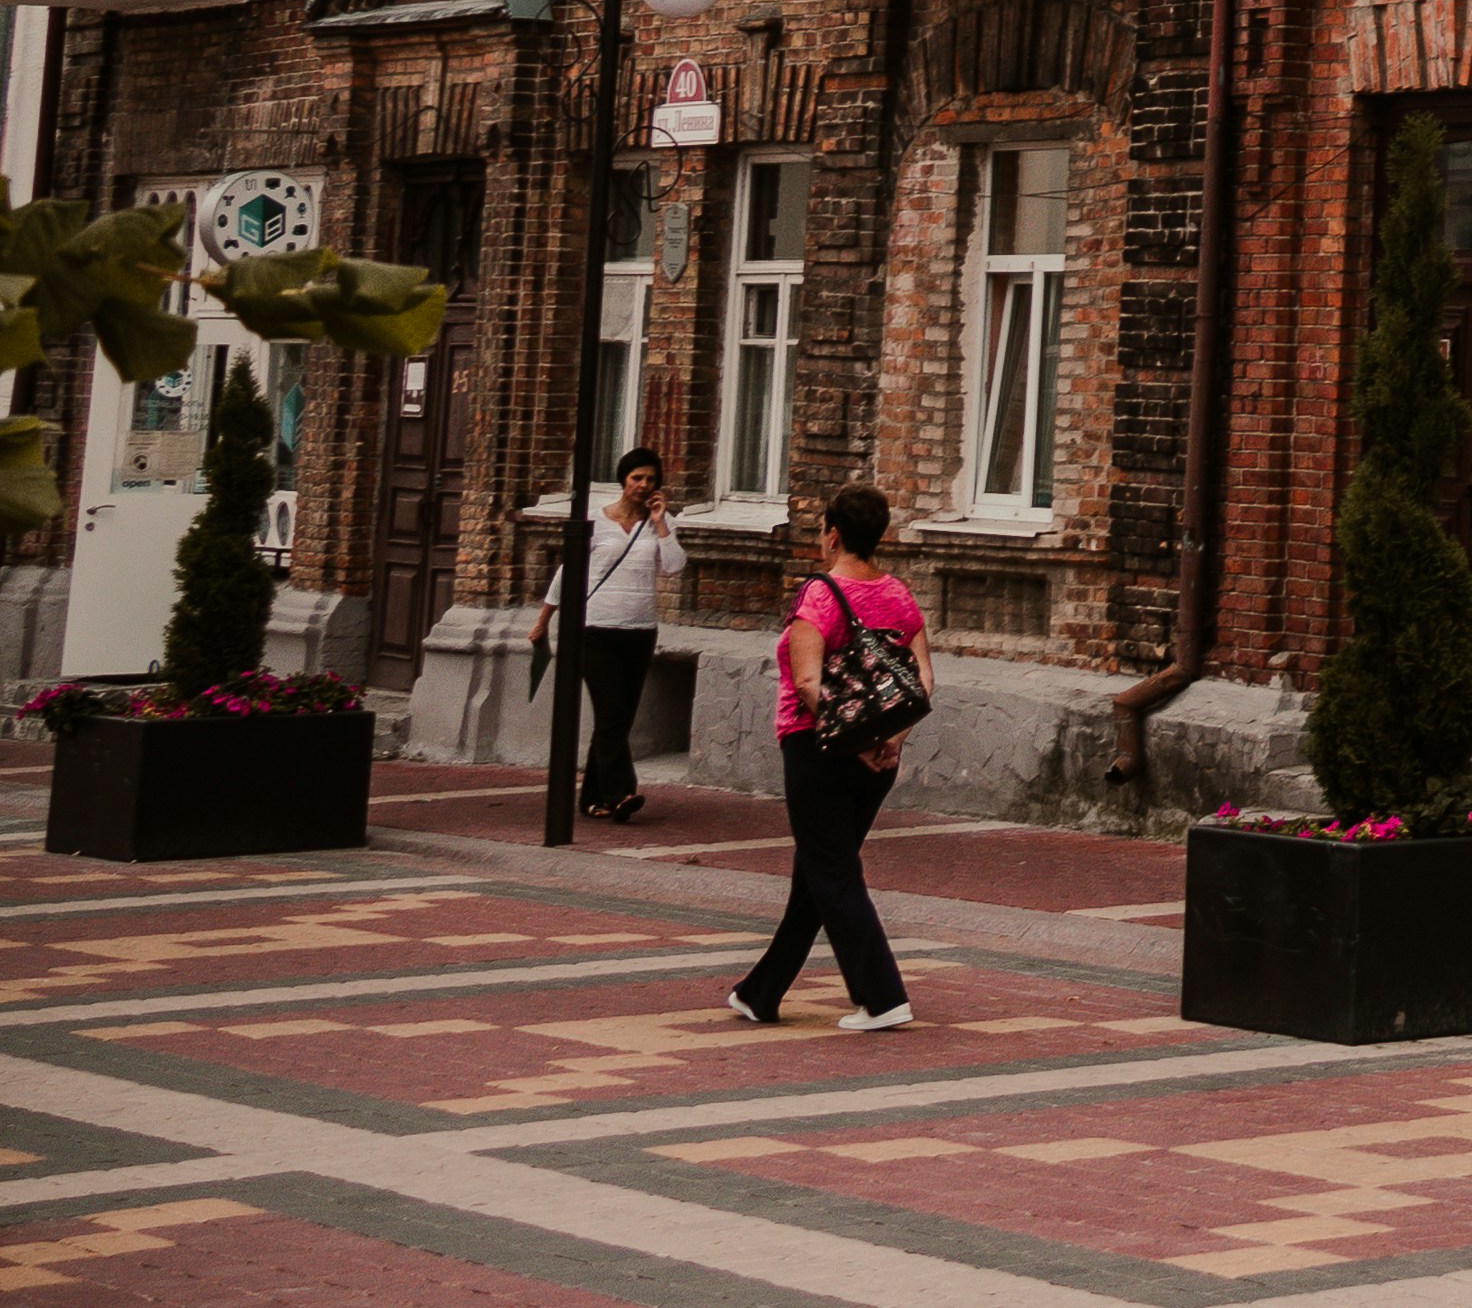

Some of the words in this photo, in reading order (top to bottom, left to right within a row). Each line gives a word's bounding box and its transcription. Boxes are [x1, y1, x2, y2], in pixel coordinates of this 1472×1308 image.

[675, 70, 697, 98] 40
[673, 110, 715, 133] Ленина
[121, 480, 151, 489] open
